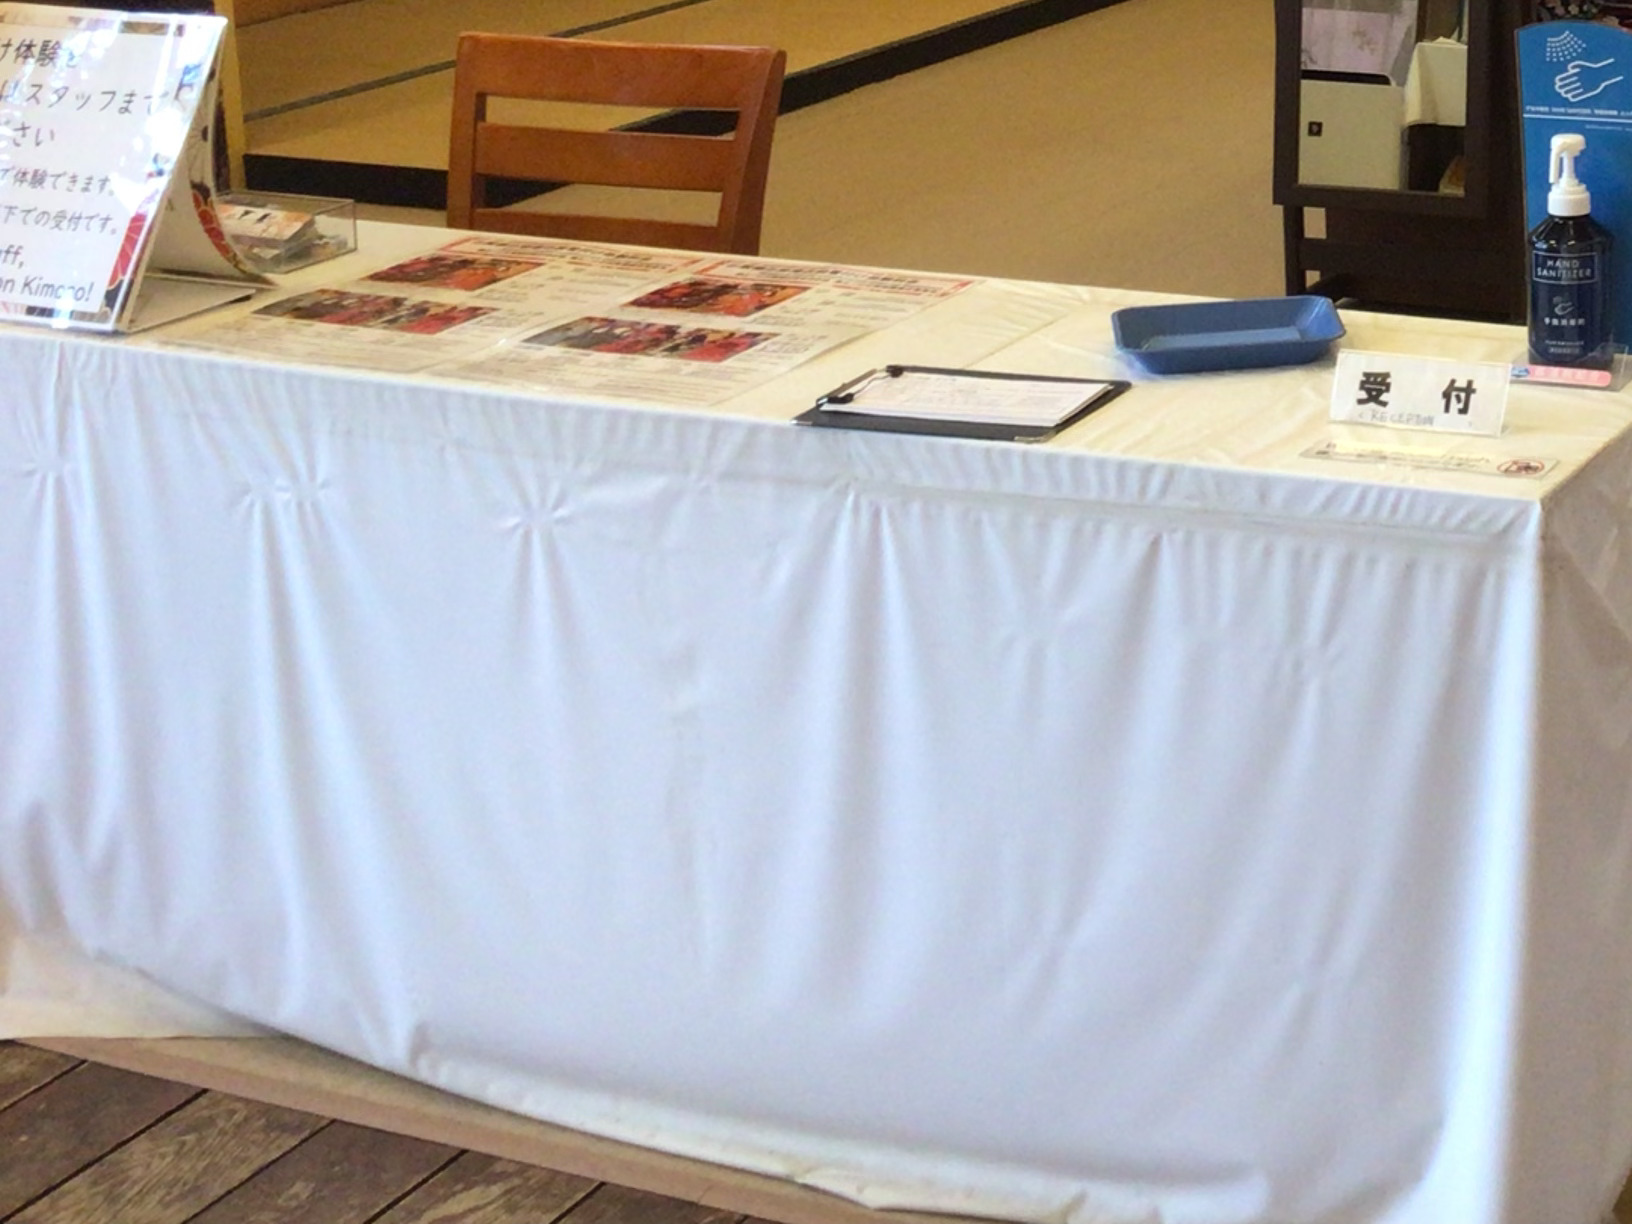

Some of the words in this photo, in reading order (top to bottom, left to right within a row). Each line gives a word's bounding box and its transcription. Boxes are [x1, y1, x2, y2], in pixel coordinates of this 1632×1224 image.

[1546, 258, 1580, 268] HAND
[1536, 267, 1592, 278] SANITIZER
[1356, 371, 1477, 415] 受付
